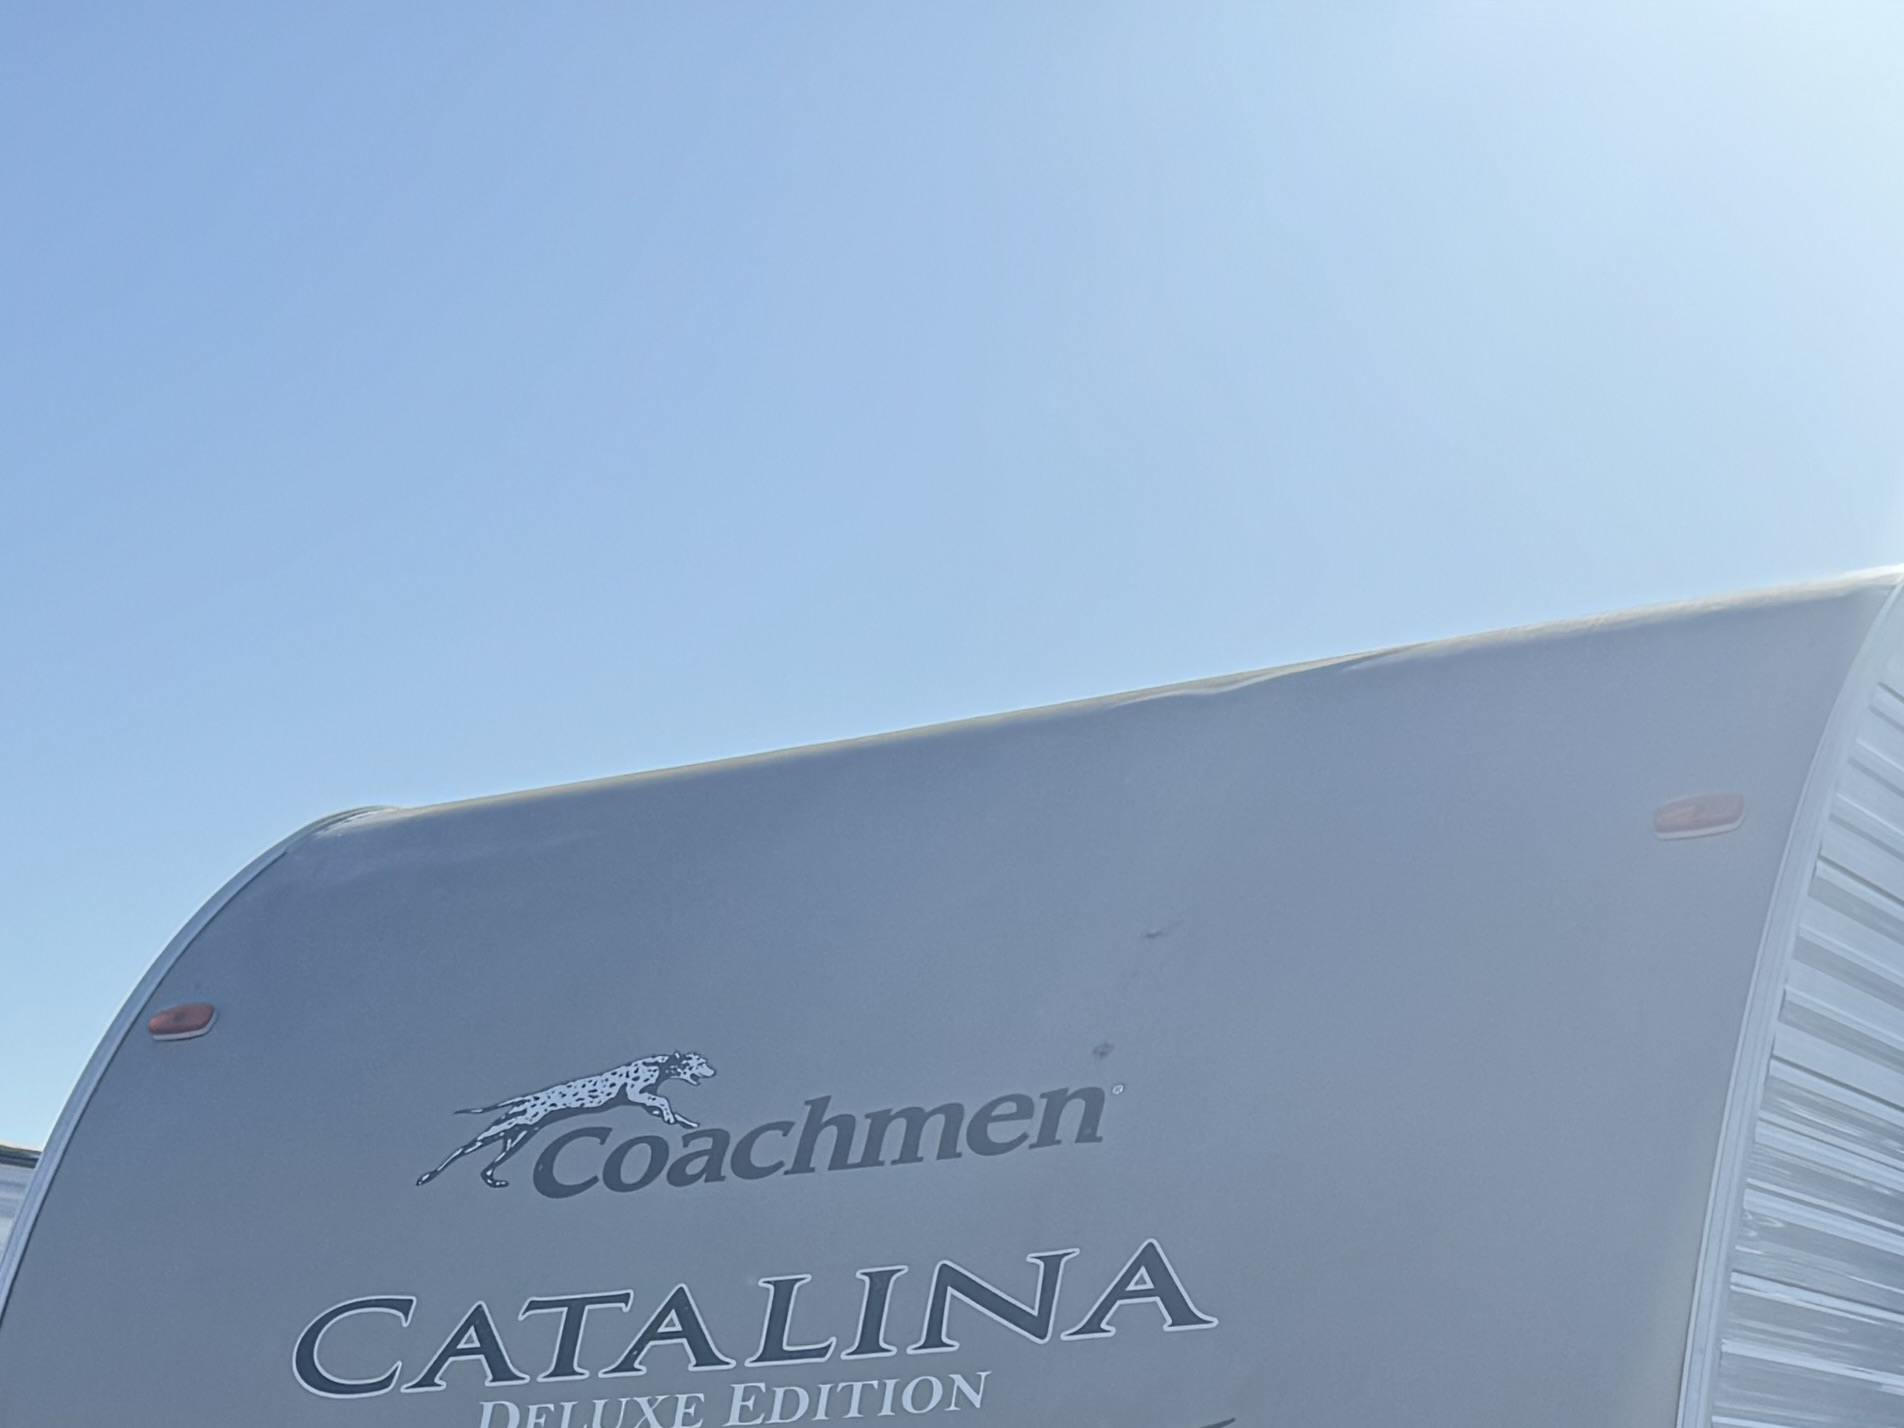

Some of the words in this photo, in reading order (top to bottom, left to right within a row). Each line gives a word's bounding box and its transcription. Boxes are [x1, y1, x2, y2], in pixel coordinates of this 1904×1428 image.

[533, 1081, 1105, 1199] Coachmen
[292, 1238, 1217, 1398] CATALINA
[722, 1370, 991, 1426] EDITION
